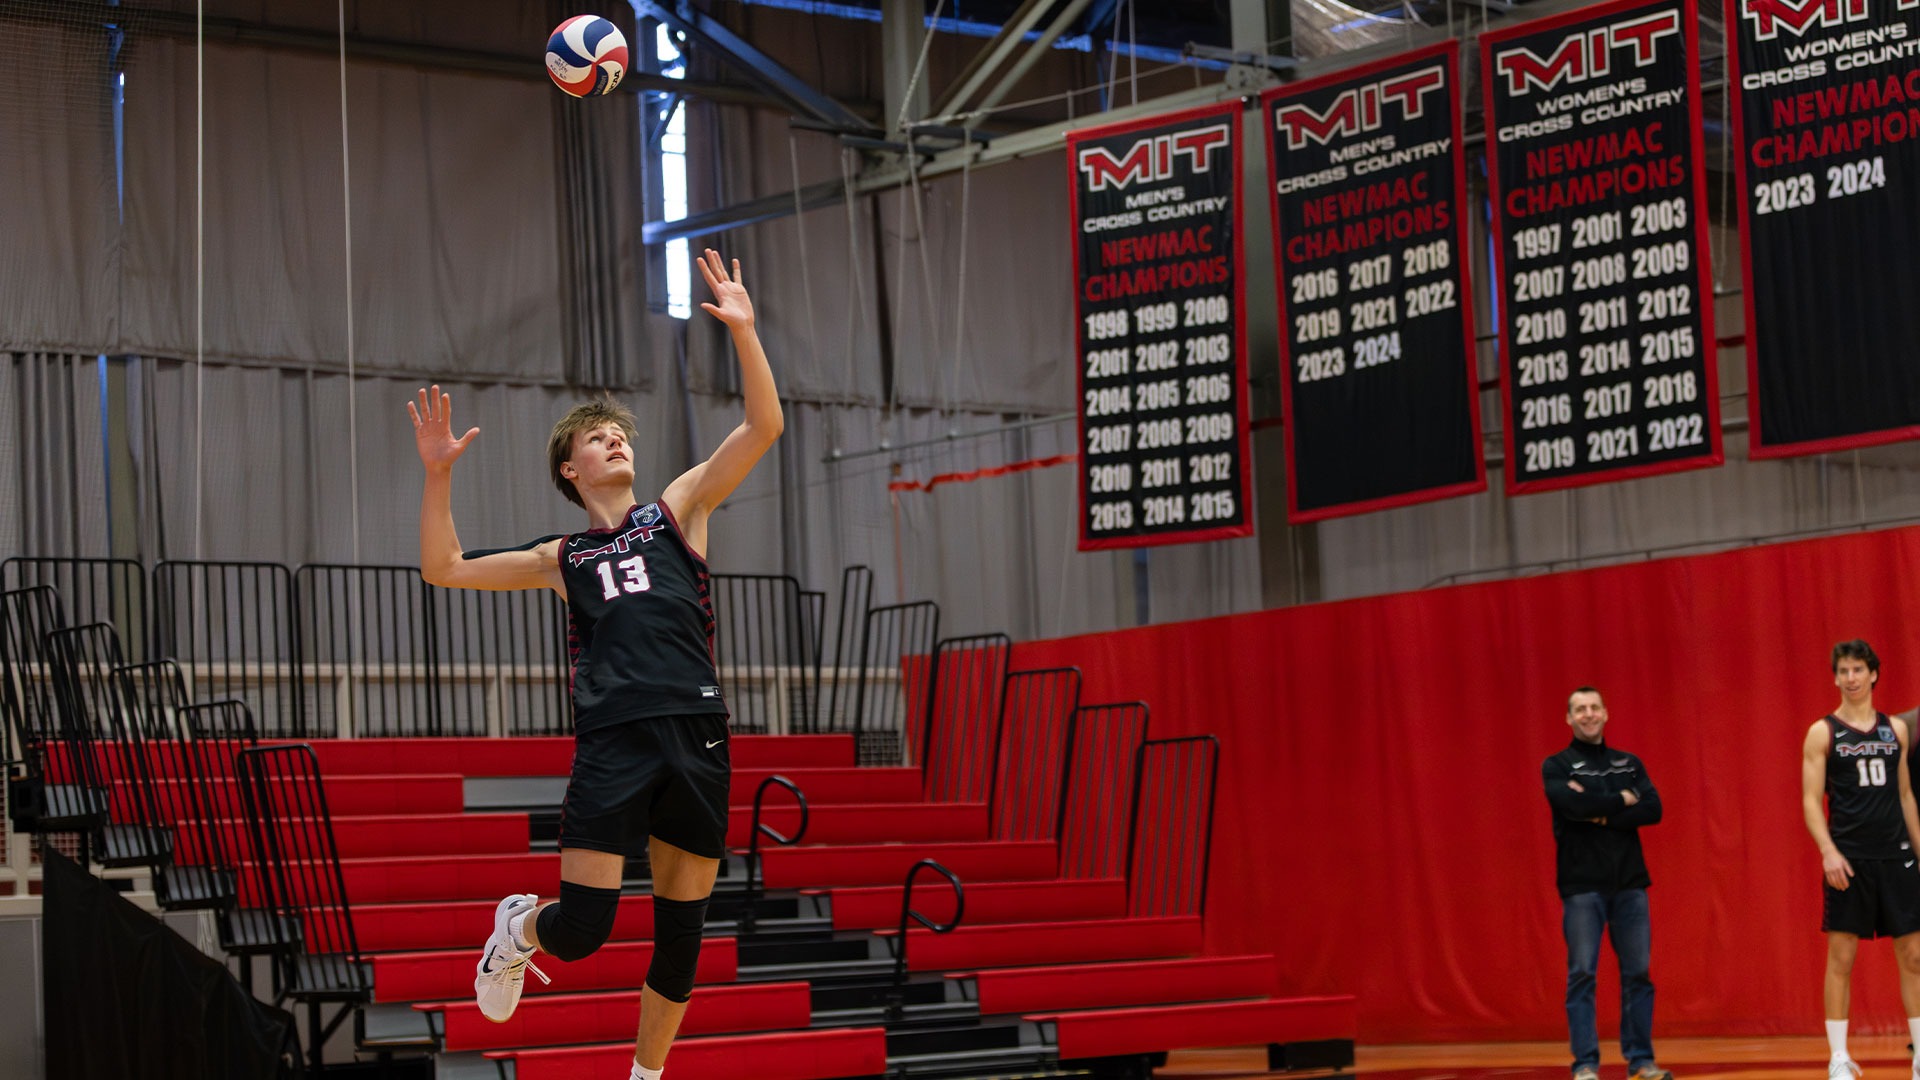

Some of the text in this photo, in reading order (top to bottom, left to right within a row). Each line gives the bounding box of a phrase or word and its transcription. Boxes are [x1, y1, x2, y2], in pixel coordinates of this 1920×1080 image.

[1497, 9, 1679, 96] MIT
[1743, 39, 1920, 90] CROSS COUNT
[1784, 22, 1907, 62] WOMEN'S
[1276, 65, 1444, 150] MIT
[1499, 87, 1683, 142] CROSS COUNTRY
[1536, 77, 1646, 115] WOMEN'S
[1773, 69, 1920, 129] NEWMAC
[1080, 124, 1229, 192] MIT
[1330, 135, 1395, 163] MEN'S
[1526, 122, 1663, 180] NEWMAC
[1752, 108, 1920, 168] CHAMPION
[1278, 138, 1451, 194] CROSS COUNTRY
[1507, 155, 1684, 217] CHAMPIONS
[1755, 156, 1885, 215] 2023 2024
[1084, 197, 1227, 233] CROSS COUNTRY
[1126, 187, 1185, 209] MEN'S
[1304, 172, 1427, 228] NEWMAC
[1103, 225, 1212, 267] NEWMAC
[1288, 201, 1449, 263] CHAMPIONS
[1513, 197, 1686, 260] 1997 2001 2003
[1086, 256, 1228, 301] CHAMPIONS
[1293, 240, 1449, 303] 2016 2017 2018
[1514, 240, 1689, 301] 2007 2008 2009
[1085, 296, 1228, 340] 1998 1999 2000
[1296, 279, 1456, 343] 2019 2021 2022
[1516, 284, 1691, 345] 2010 2011 2012
[1087, 334, 1229, 378] 2001 2002 2003
[1298, 331, 1400, 383] 2023 2024
[1518, 326, 1694, 387] 2013 2014 2015
[1086, 373, 1230, 416] 2004 2005 2006
[1522, 370, 1697, 430] 2016 2017 2018
[1088, 412, 1232, 454] 2007 2008 2009
[1525, 413, 1702, 472] 2019 2021 2022
[1090, 452, 1231, 492] 2010 2011 2012
[1091, 491, 1234, 530] 2013 2014 2015
[596, 555, 651, 601] 13
[1835, 742, 1898, 757] MIT
[1856, 758, 1887, 787] 10
